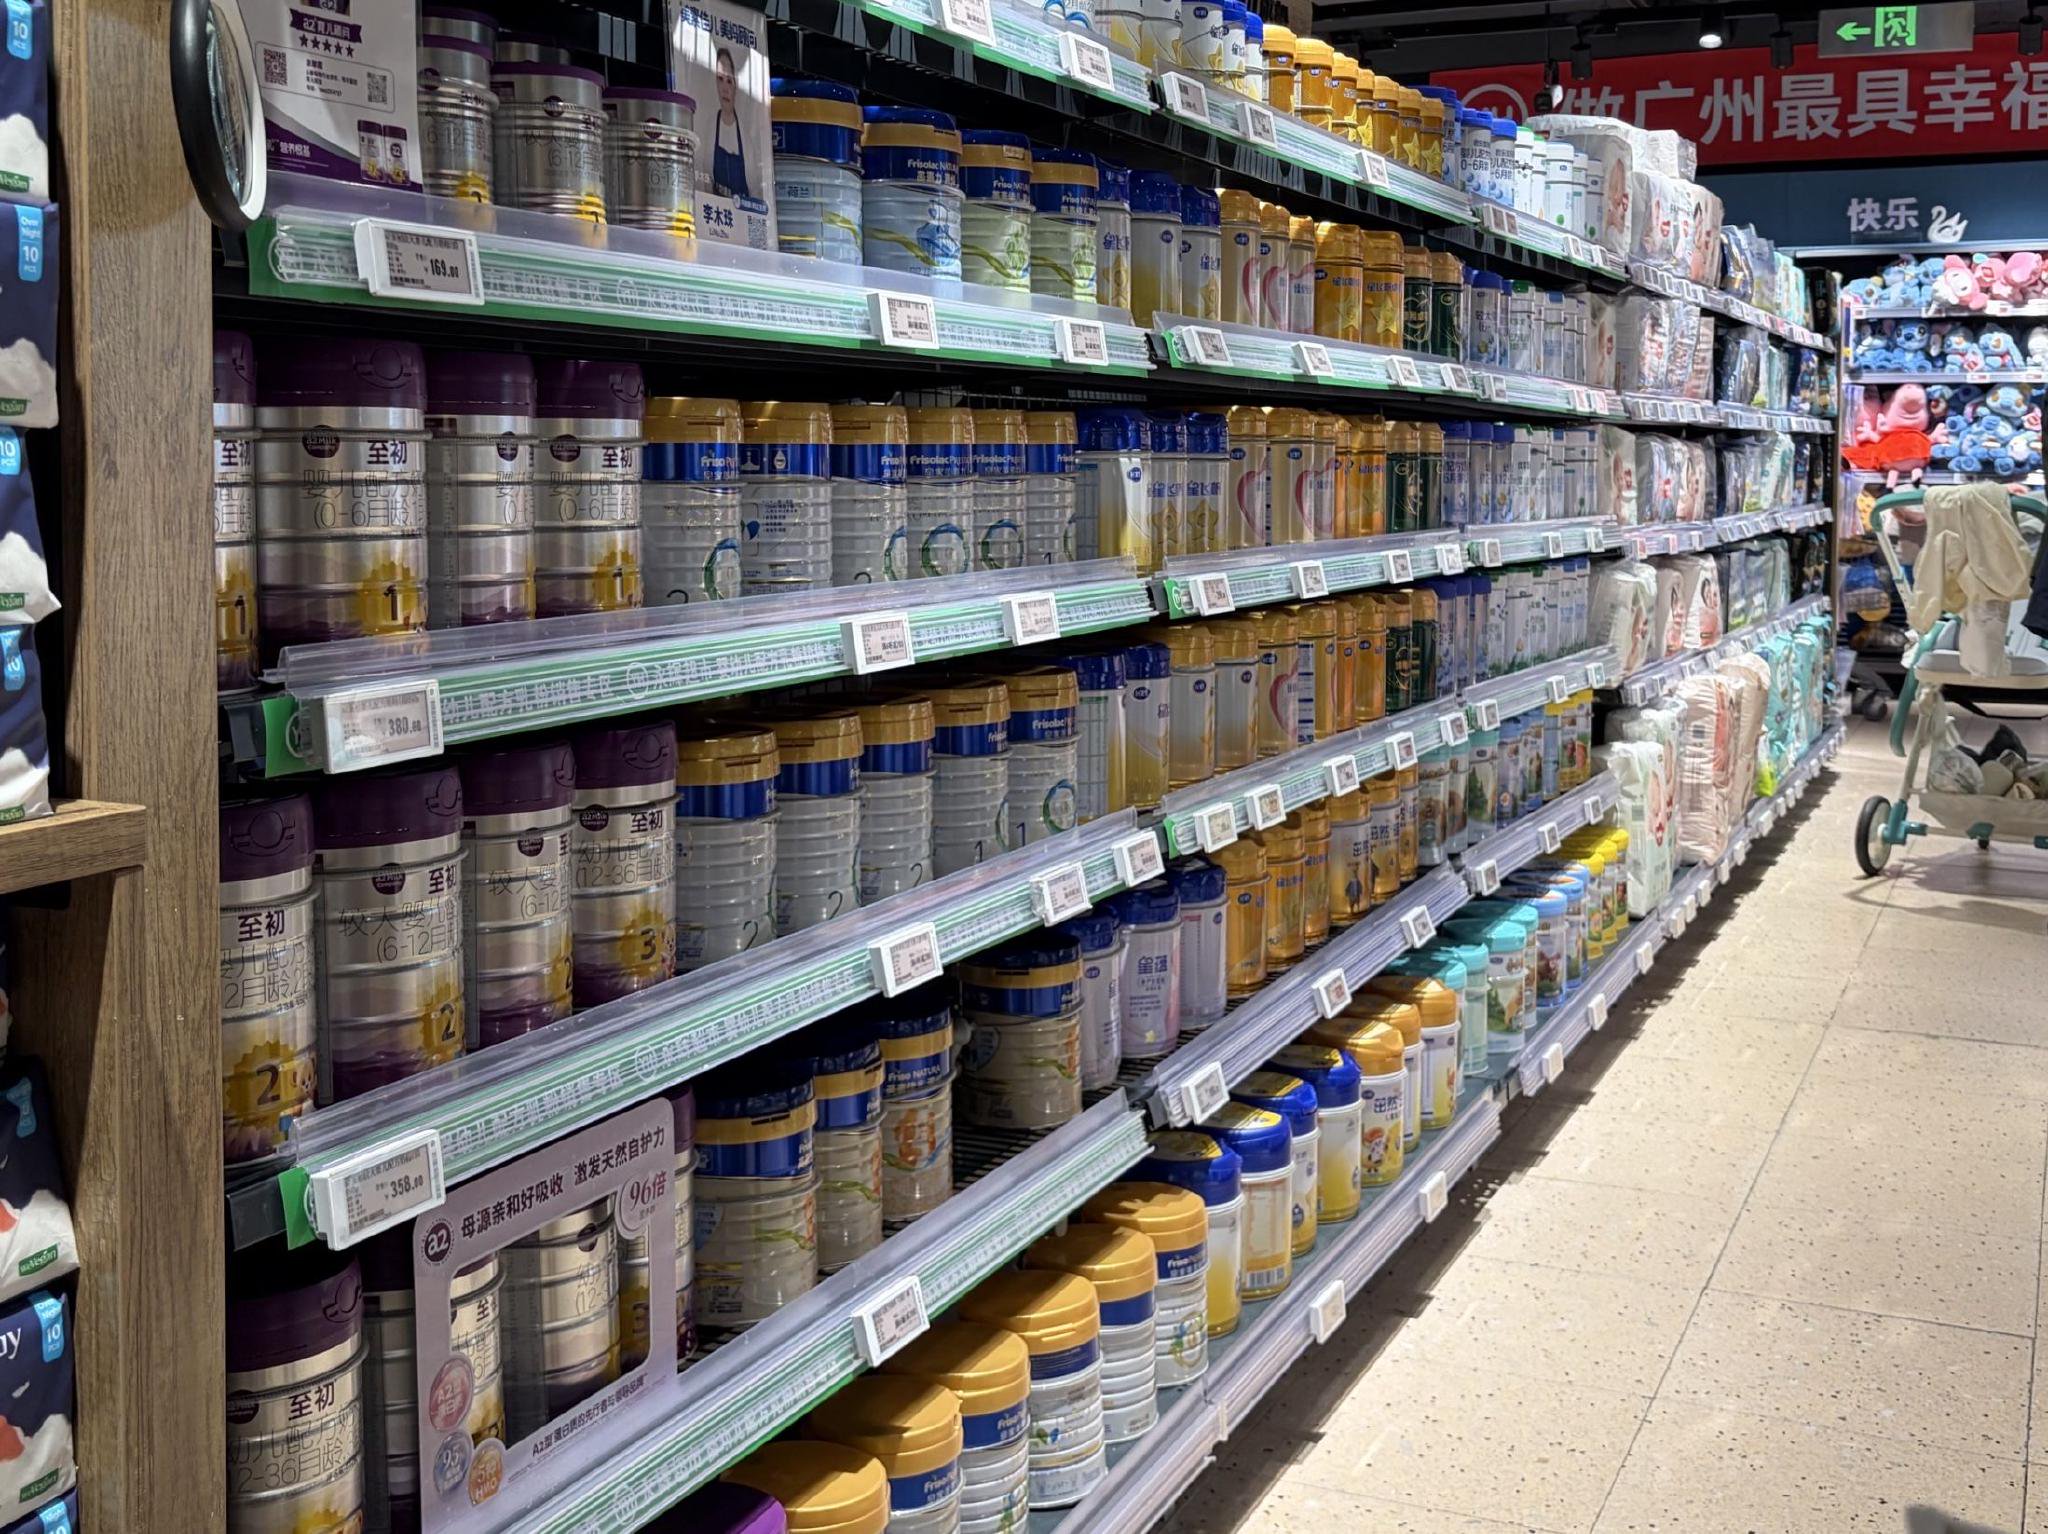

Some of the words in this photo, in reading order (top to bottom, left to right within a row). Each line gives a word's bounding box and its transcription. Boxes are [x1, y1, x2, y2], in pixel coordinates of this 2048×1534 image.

[14, 21, 29, 40] 10
[703, 204, 734, 228] 李木珠
[1847, 197, 1919, 232] 快乐
[23, 245, 39, 263] 10
[367, 440, 407, 465] 至初
[602, 445, 634, 469] 至初
[701, 456, 724, 468] Friso
[909, 456, 950, 468] Frisolac
[235, 594, 246, 635] 1
[384, 583, 398, 622] 1
[630, 809, 663, 834] 至初
[428, 864, 457, 895] 至初
[237, 909, 286, 943] 至初
[640, 927, 657, 961] 3
[440, 1003, 456, 1042] 2
[256, 1063, 282, 1106] 2
[461, 1173, 564, 1240] 母源亲和好吸收
[573, 1125, 666, 1187] 激发天然自护力
[629, 1170, 667, 1206] 96倍
[427, 1231, 450, 1258] a2
[46, 1324, 62, 1342] 10
[288, 1380, 336, 1421] 至初
